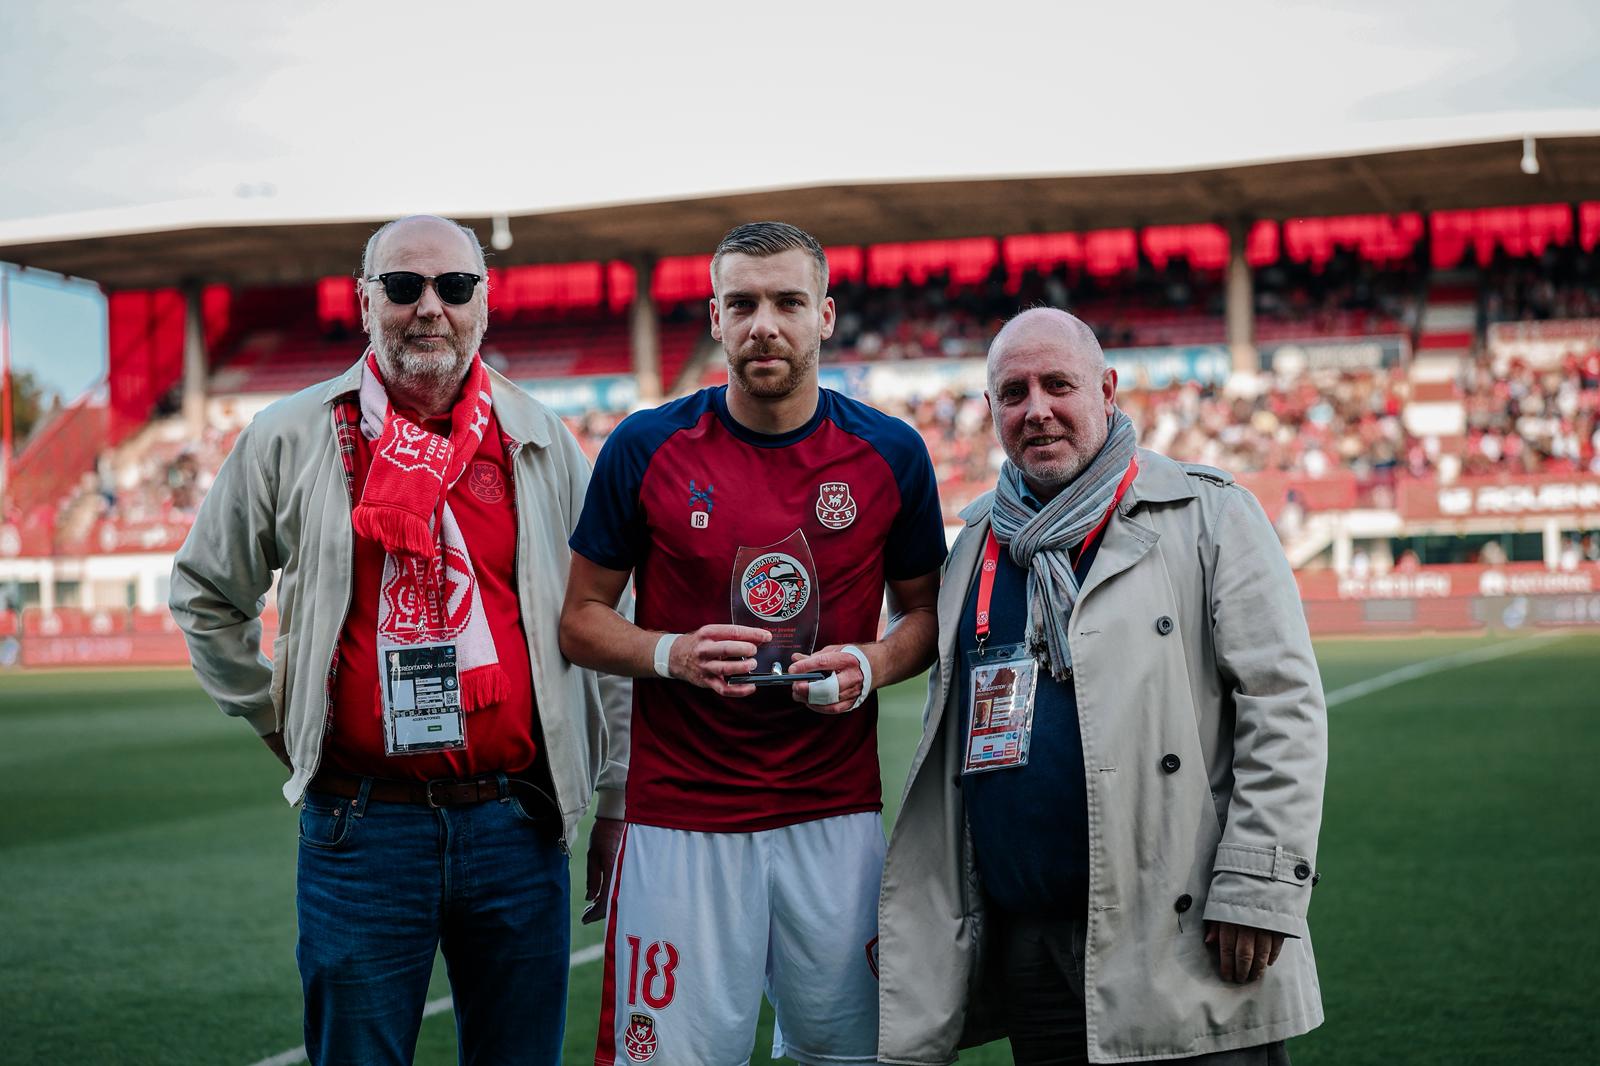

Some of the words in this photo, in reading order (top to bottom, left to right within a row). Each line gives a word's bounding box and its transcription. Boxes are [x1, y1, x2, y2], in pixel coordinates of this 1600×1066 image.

[695, 514, 705, 527] 18
[746, 556, 780, 579] FEDERATION
[626, 933, 680, 1010] 18
